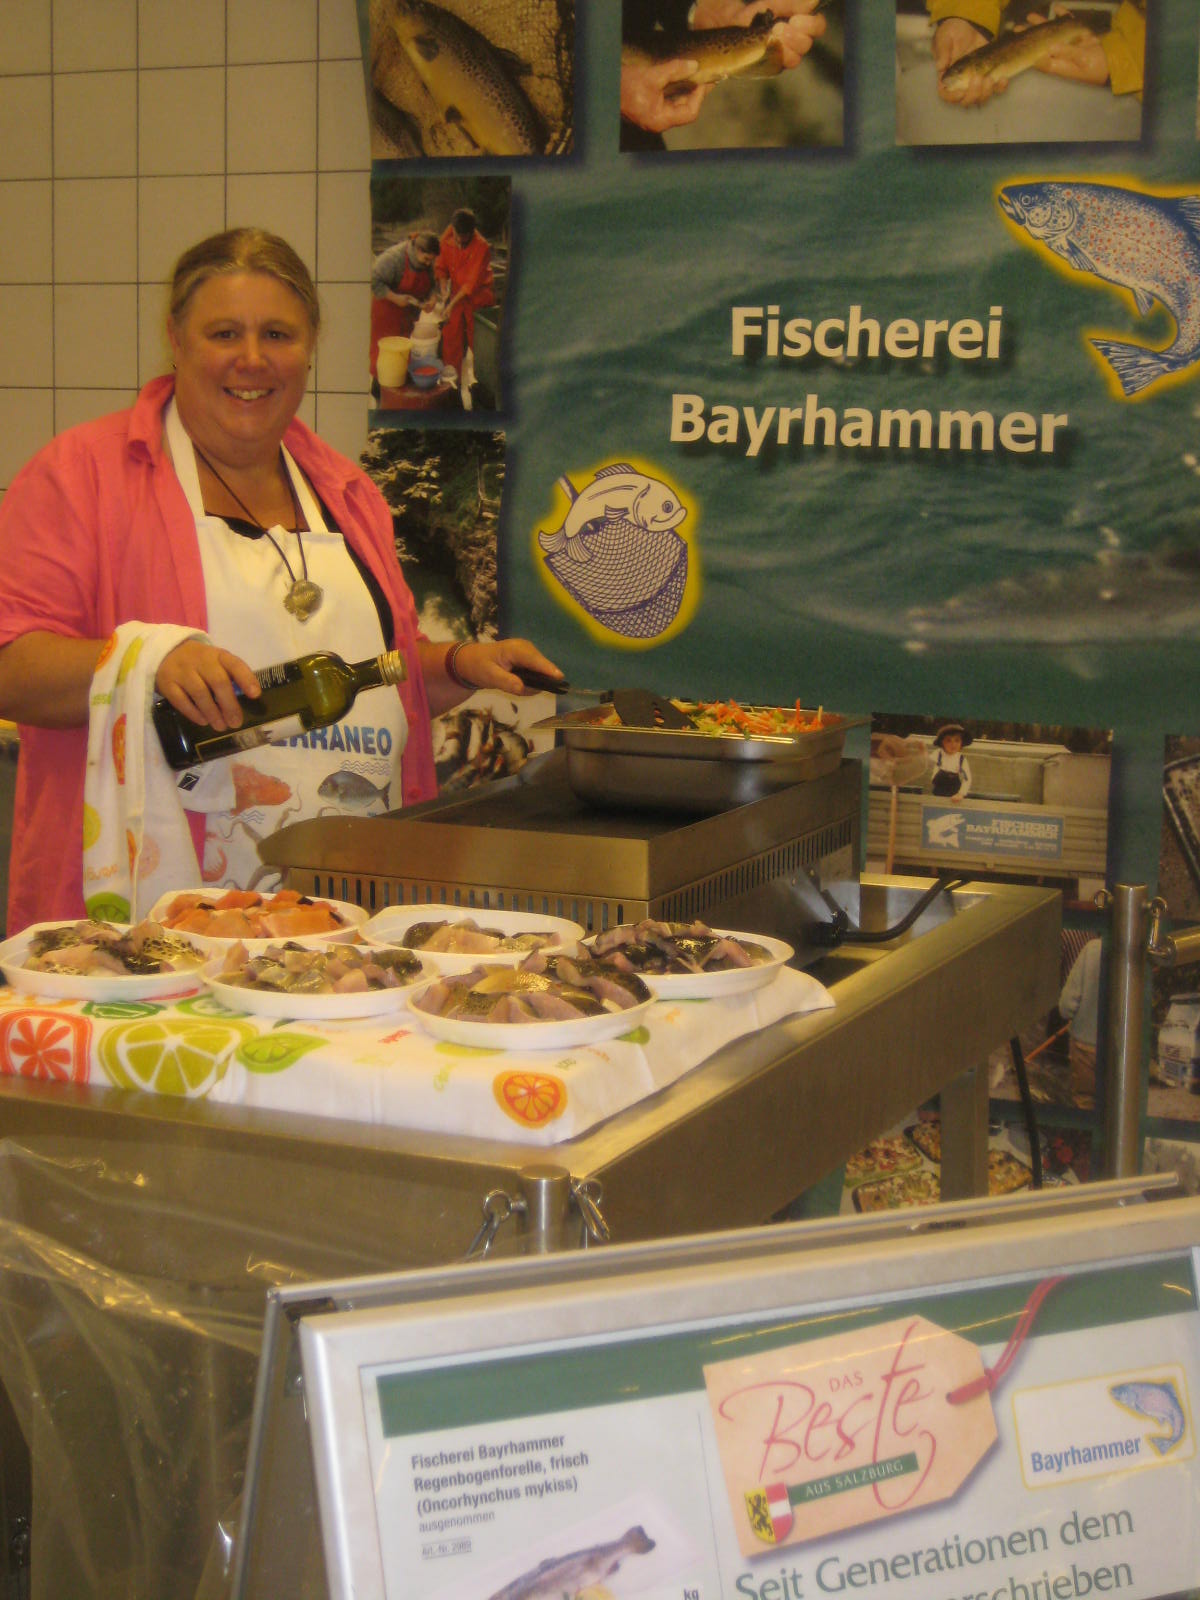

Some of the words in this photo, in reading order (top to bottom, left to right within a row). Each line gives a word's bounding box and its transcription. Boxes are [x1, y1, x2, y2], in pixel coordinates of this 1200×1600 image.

[731, 305, 1003, 359] Fischerei
[669, 393, 1069, 457] Bayrhammer
[829, 1371, 864, 1393] DAS
[718, 1320, 937, 1510] Beste
[411, 1446, 475, 1470] Fischerei
[478, 1435, 566, 1460] Bayrhammer
[413, 1460, 547, 1493] Regenbogenforelle,
[550, 1452, 589, 1471] frisch
[1031, 1438, 1141, 1473] Bayrhammer
[417, 1487, 521, 1518] (Oncorhynchus
[525, 1475, 579, 1499] mykiss)
[806, 1483, 832, 1498] AUS
[836, 1460, 905, 1490] SALZBURG
[419, 1511, 496, 1533] ausgenommen
[735, 1567, 804, 1600] Seit
[815, 1525, 1050, 1593] Generationen
[1059, 1510, 1135, 1546] dem
